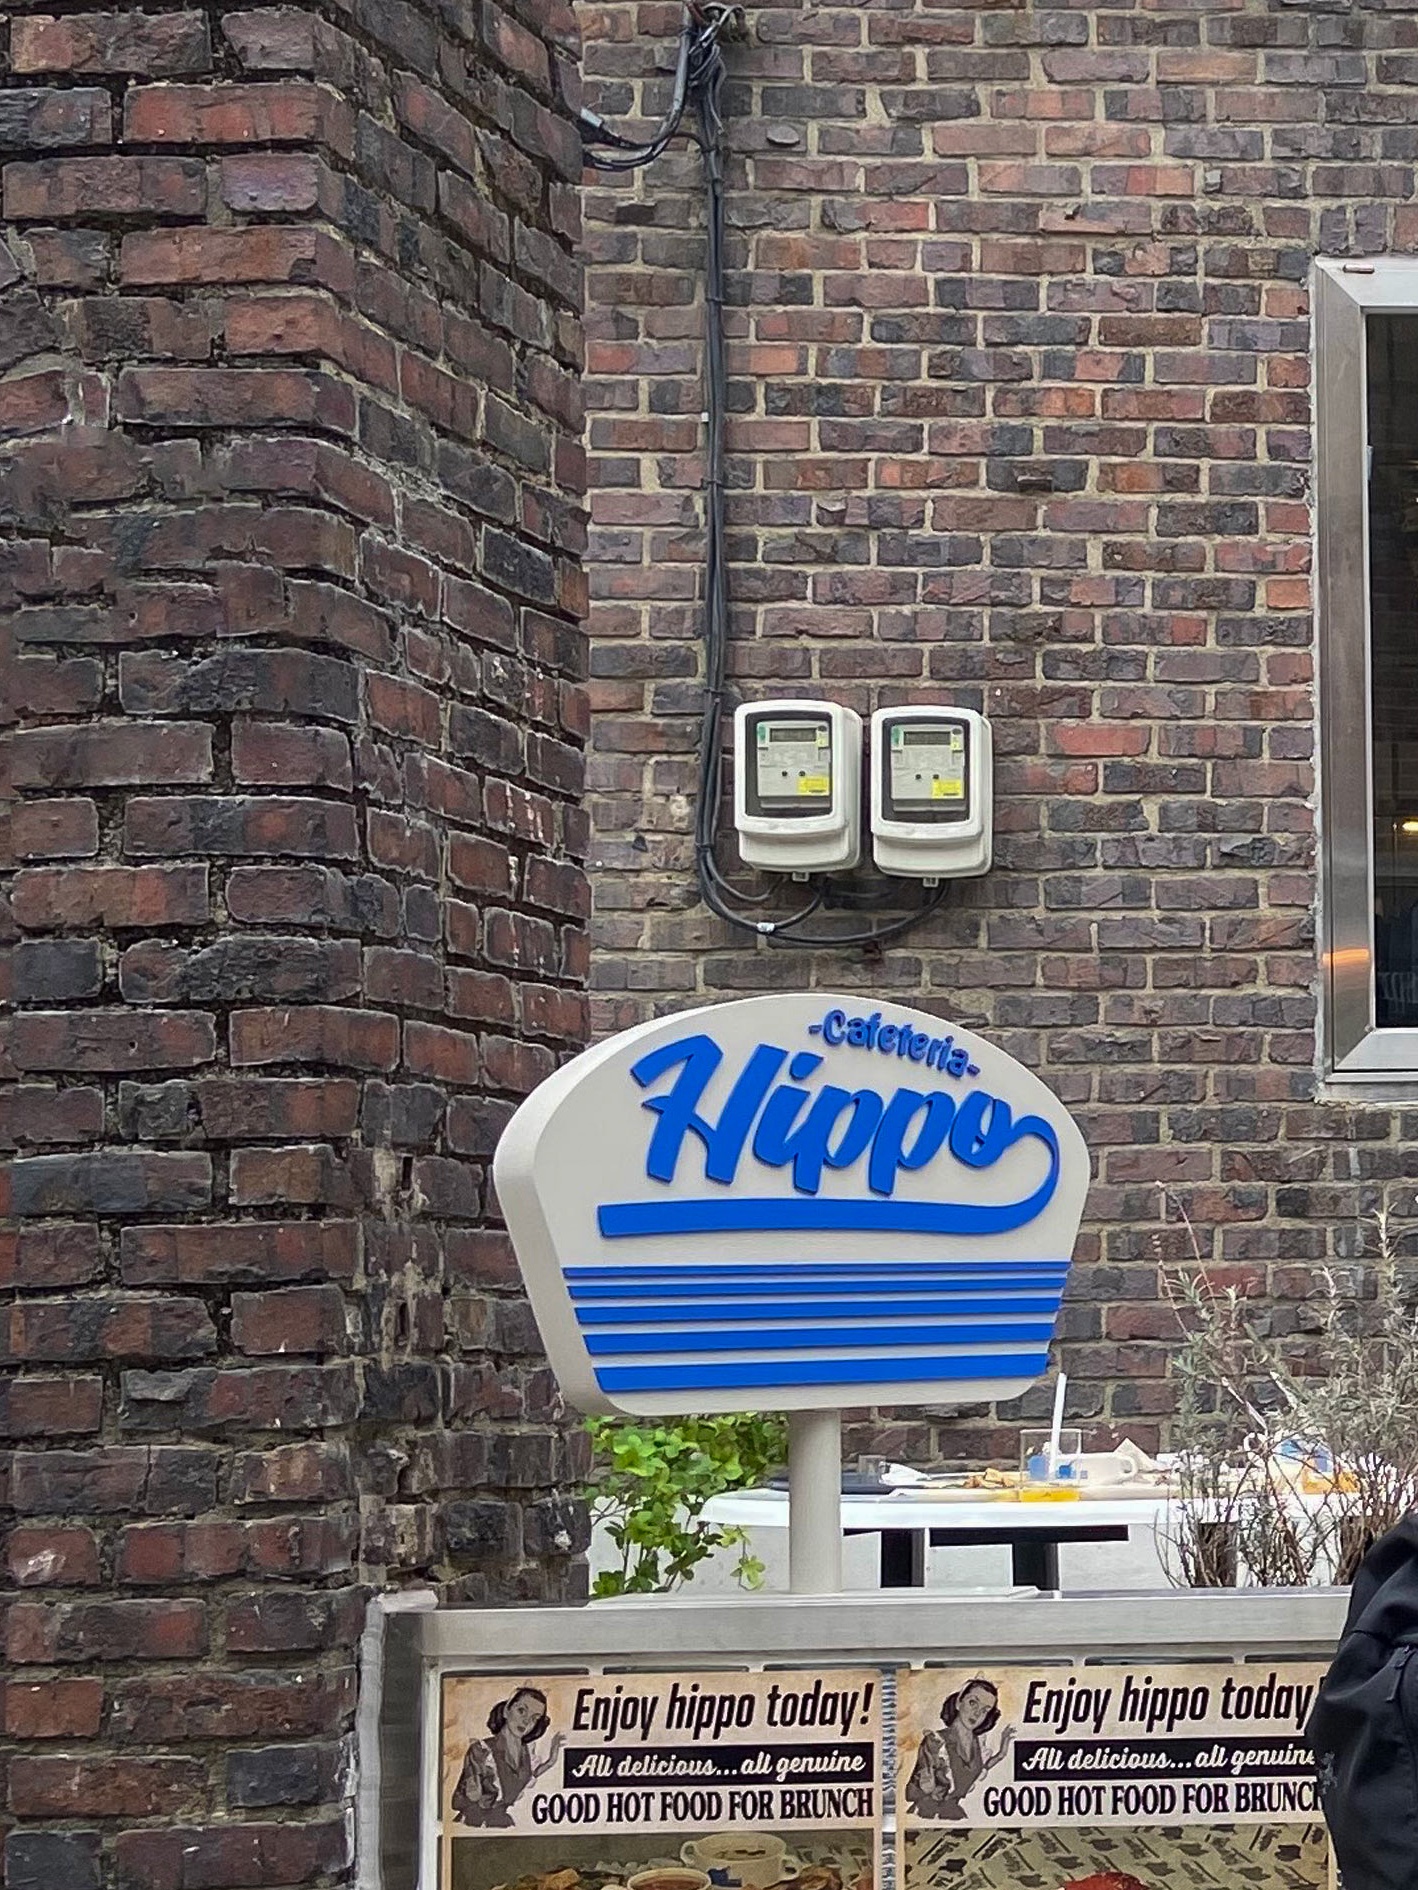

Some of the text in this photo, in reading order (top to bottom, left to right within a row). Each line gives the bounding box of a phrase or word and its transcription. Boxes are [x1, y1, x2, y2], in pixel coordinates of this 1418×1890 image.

[628, 1033, 1030, 1197] Hippo
[572, 1680, 875, 1742] Enjoy hippo today!
[1022, 1673, 1326, 1735] Enjoy hippo today
[571, 1754, 614, 1778] All
[775, 1749, 867, 1783] genuine
[1021, 1747, 1065, 1771] All
[531, 1787, 875, 1825] GOOD HOT FOOD FOR BRUNCH
[983, 1786, 1052, 1817] GOOD
[1057, 1785, 1107, 1816] HOT
[1111, 1784, 1177, 1816] FOOD
[1182, 1783, 1230, 1815] FOR
